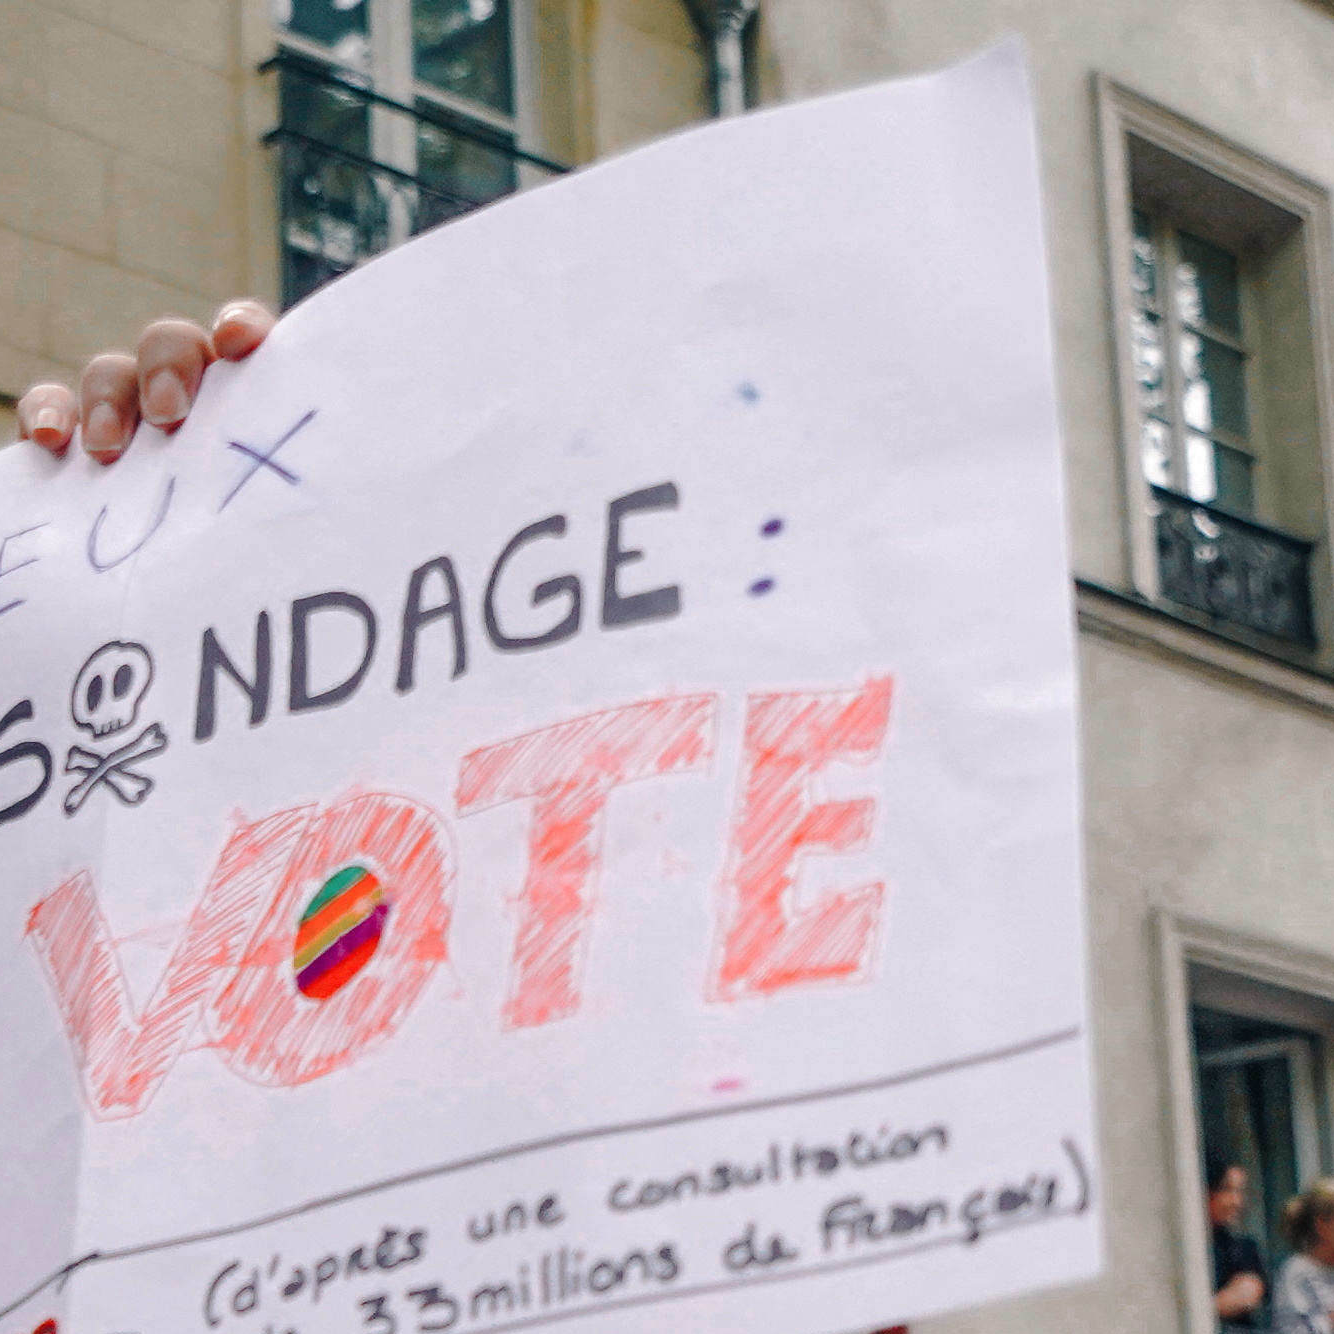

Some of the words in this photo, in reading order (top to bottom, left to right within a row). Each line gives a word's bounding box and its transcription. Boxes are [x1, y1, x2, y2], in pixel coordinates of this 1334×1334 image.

[23, 672, 895, 1123] VOTE
[468, 1195, 565, 1242] une
[608, 1124, 950, 1212] consultation
[723, 1222, 798, 1274] de
